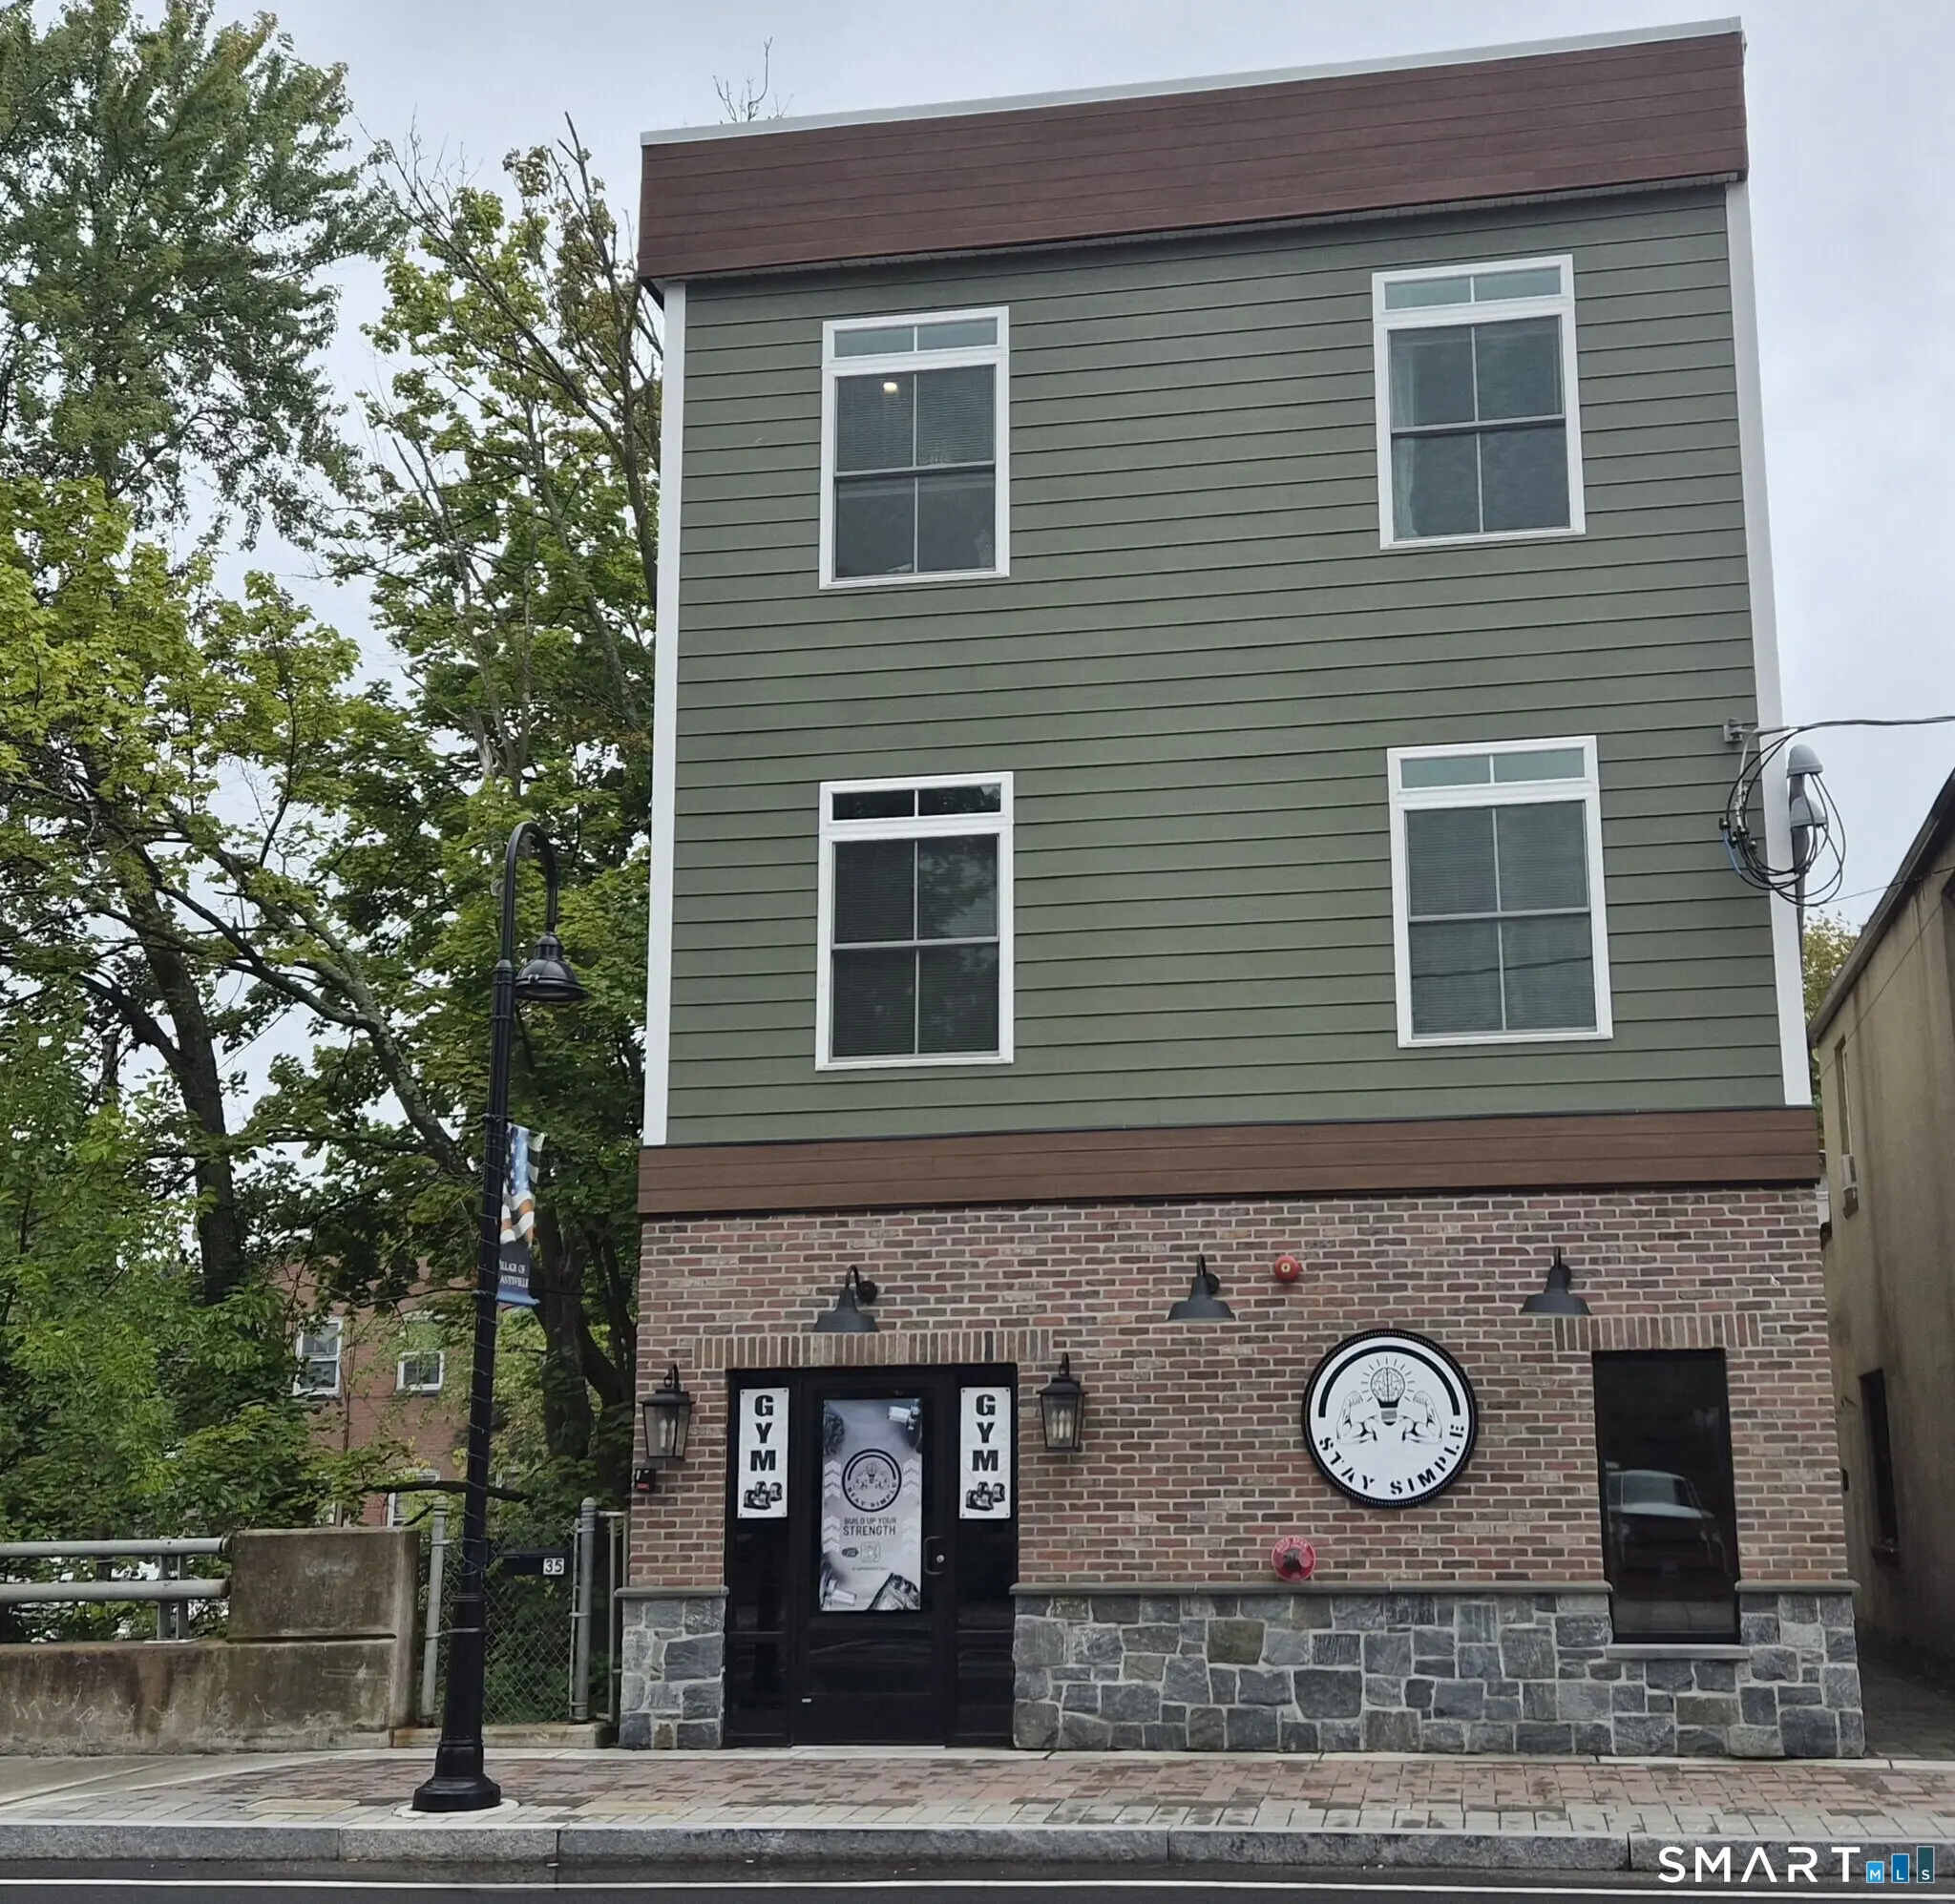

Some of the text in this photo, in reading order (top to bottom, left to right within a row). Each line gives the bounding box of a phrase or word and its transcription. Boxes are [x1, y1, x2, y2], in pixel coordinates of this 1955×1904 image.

[750, 1394, 776, 1472] GYM
[972, 1394, 999, 1472] GYM
[1319, 1424, 1464, 1496] STAY SIMPLE
[545, 1559, 562, 1573] 35
[843, 1525, 896, 1536] STRENGTH
